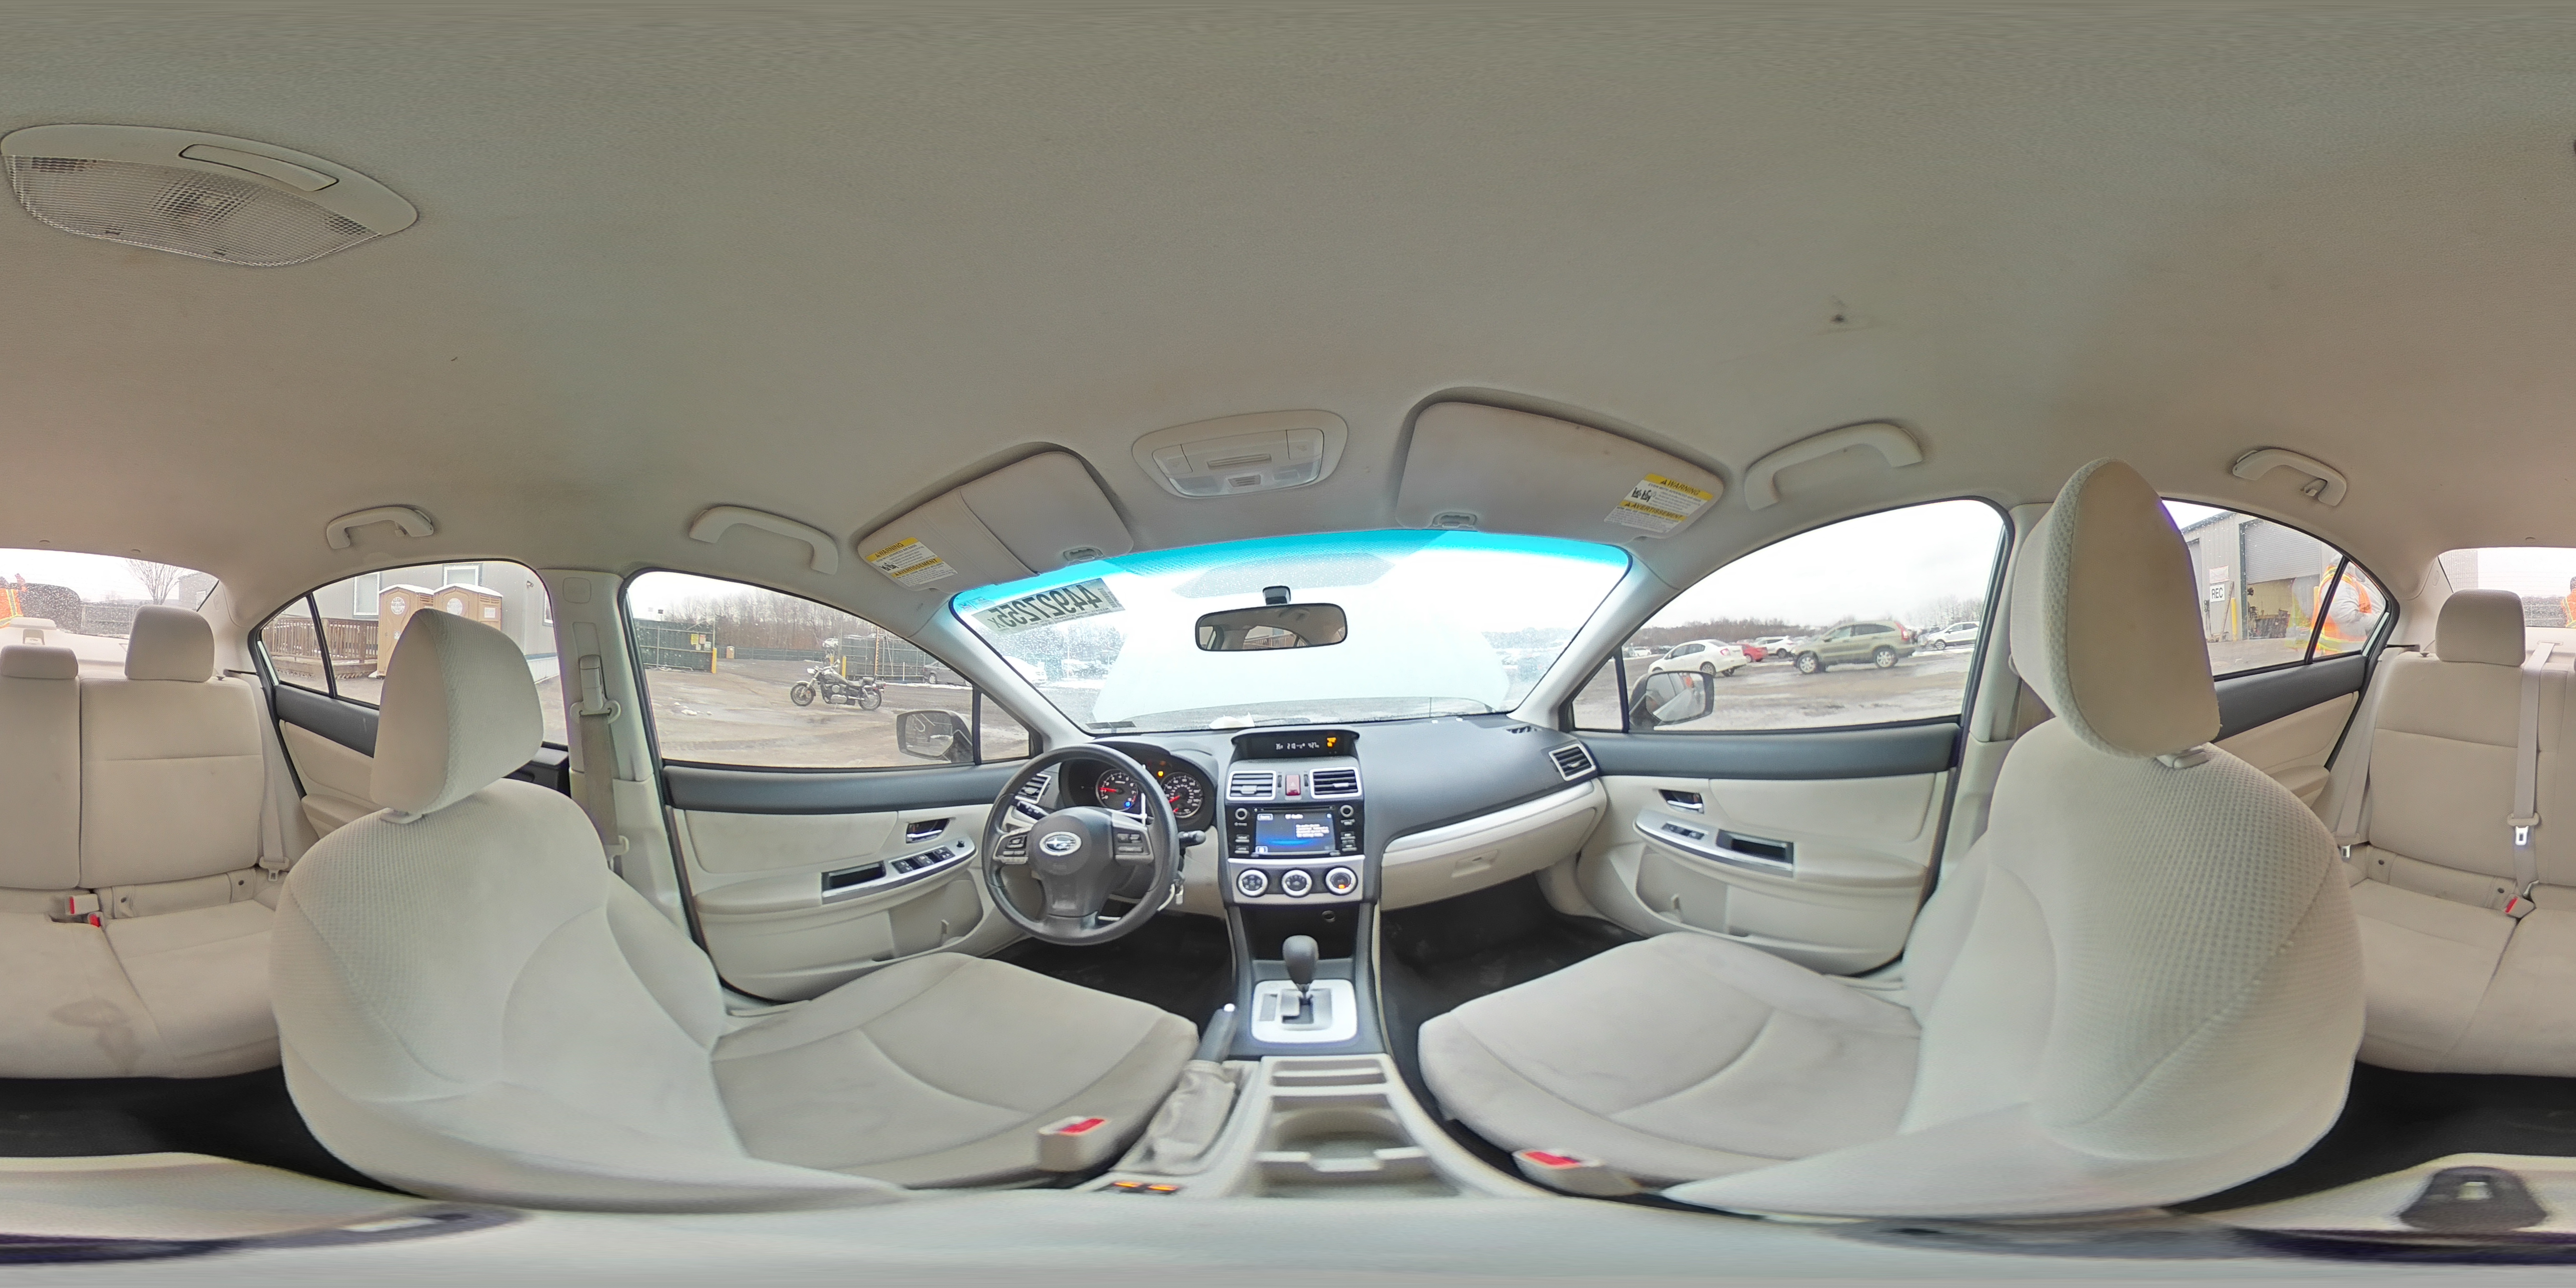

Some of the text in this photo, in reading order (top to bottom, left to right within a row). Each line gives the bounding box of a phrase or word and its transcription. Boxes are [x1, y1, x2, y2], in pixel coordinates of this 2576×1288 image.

[1667, 480, 1701, 496] WARNING
[1632, 503, 1683, 520] AVERTISSEMENT
[878, 542, 904, 557] WARNING
[899, 559, 938, 575] AVERTISSEMENT
[2211, 587, 2223, 599] REC
